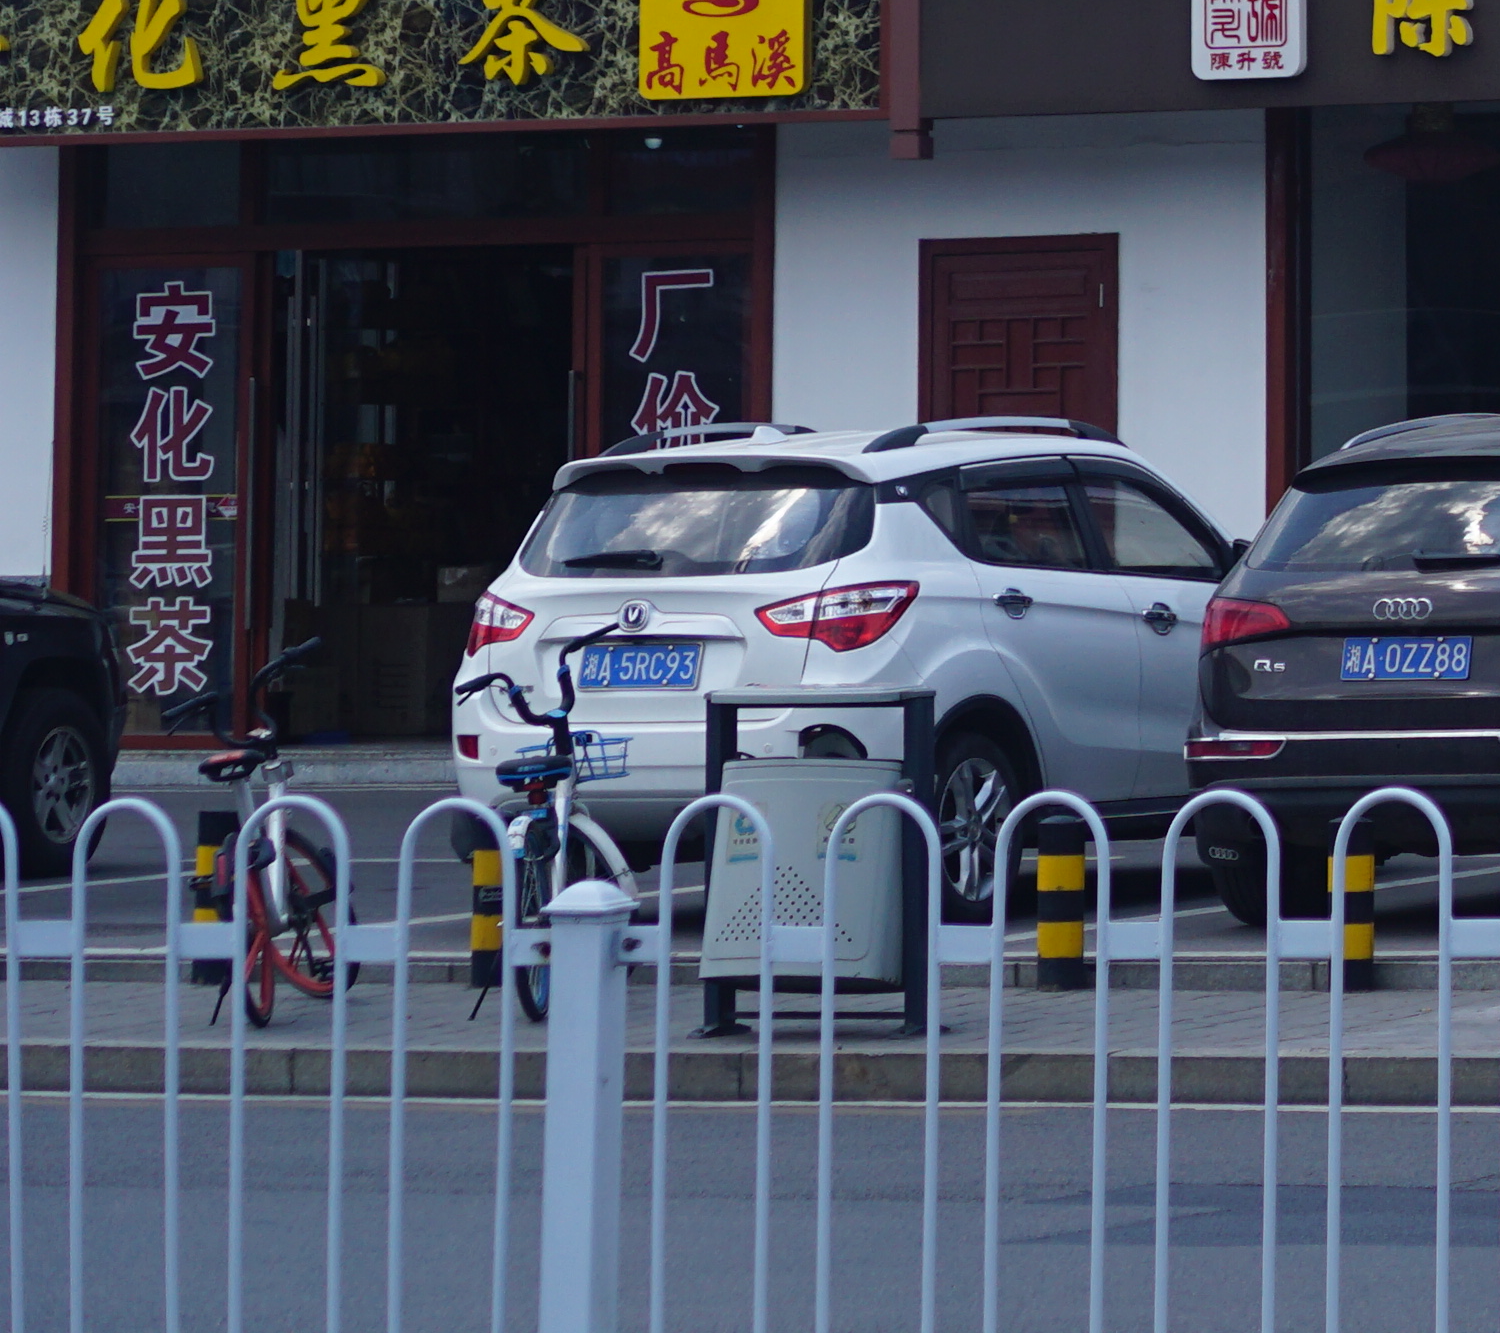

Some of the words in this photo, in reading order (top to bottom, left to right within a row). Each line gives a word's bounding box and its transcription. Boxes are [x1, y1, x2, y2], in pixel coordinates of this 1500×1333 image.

[628, 269, 720, 448] 厂价
[128, 280, 216, 697] 安化黑茶
[583, 651, 696, 681] 湘A·5RC93
[1253, 658, 1286, 674] Q5
